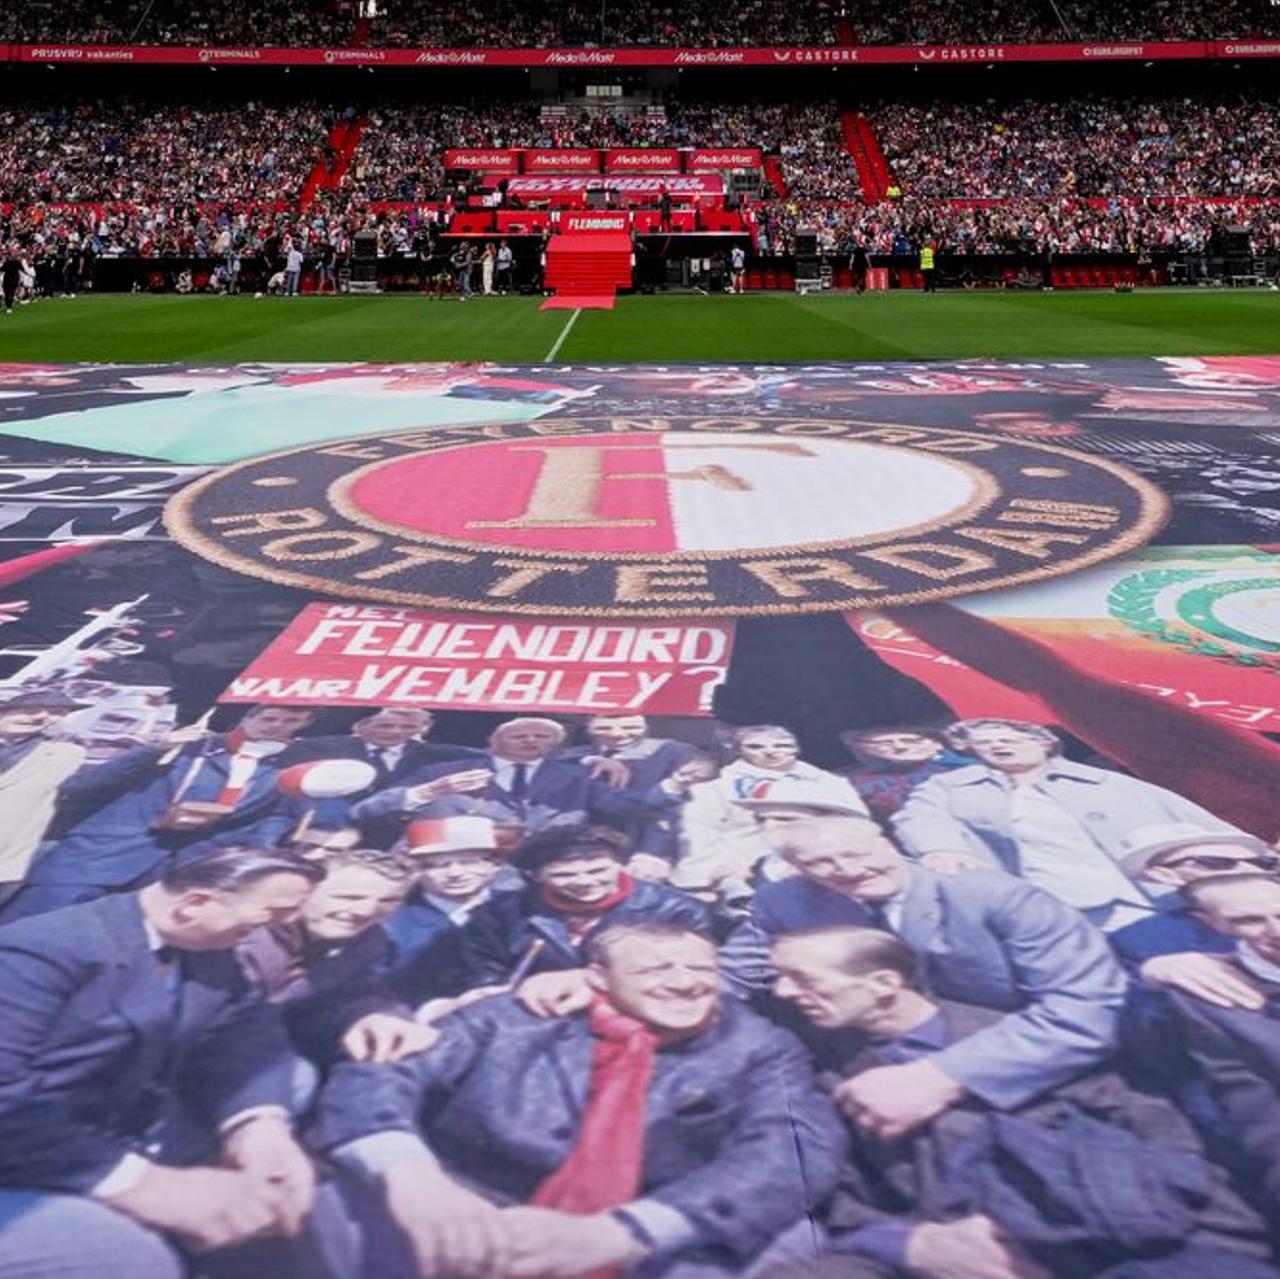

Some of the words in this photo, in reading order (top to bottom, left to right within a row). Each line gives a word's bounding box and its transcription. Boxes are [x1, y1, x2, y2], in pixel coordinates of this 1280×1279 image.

[87, 50, 133, 60] vakanties
[795, 50, 858, 61] CASTORE
[941, 48, 1004, 59] CASTORE
[568, 218, 624, 230] FLEMMING
[320, 417, 1000, 461] FEYENOORD
[210, 496, 1122, 604] ROTTERDAM
